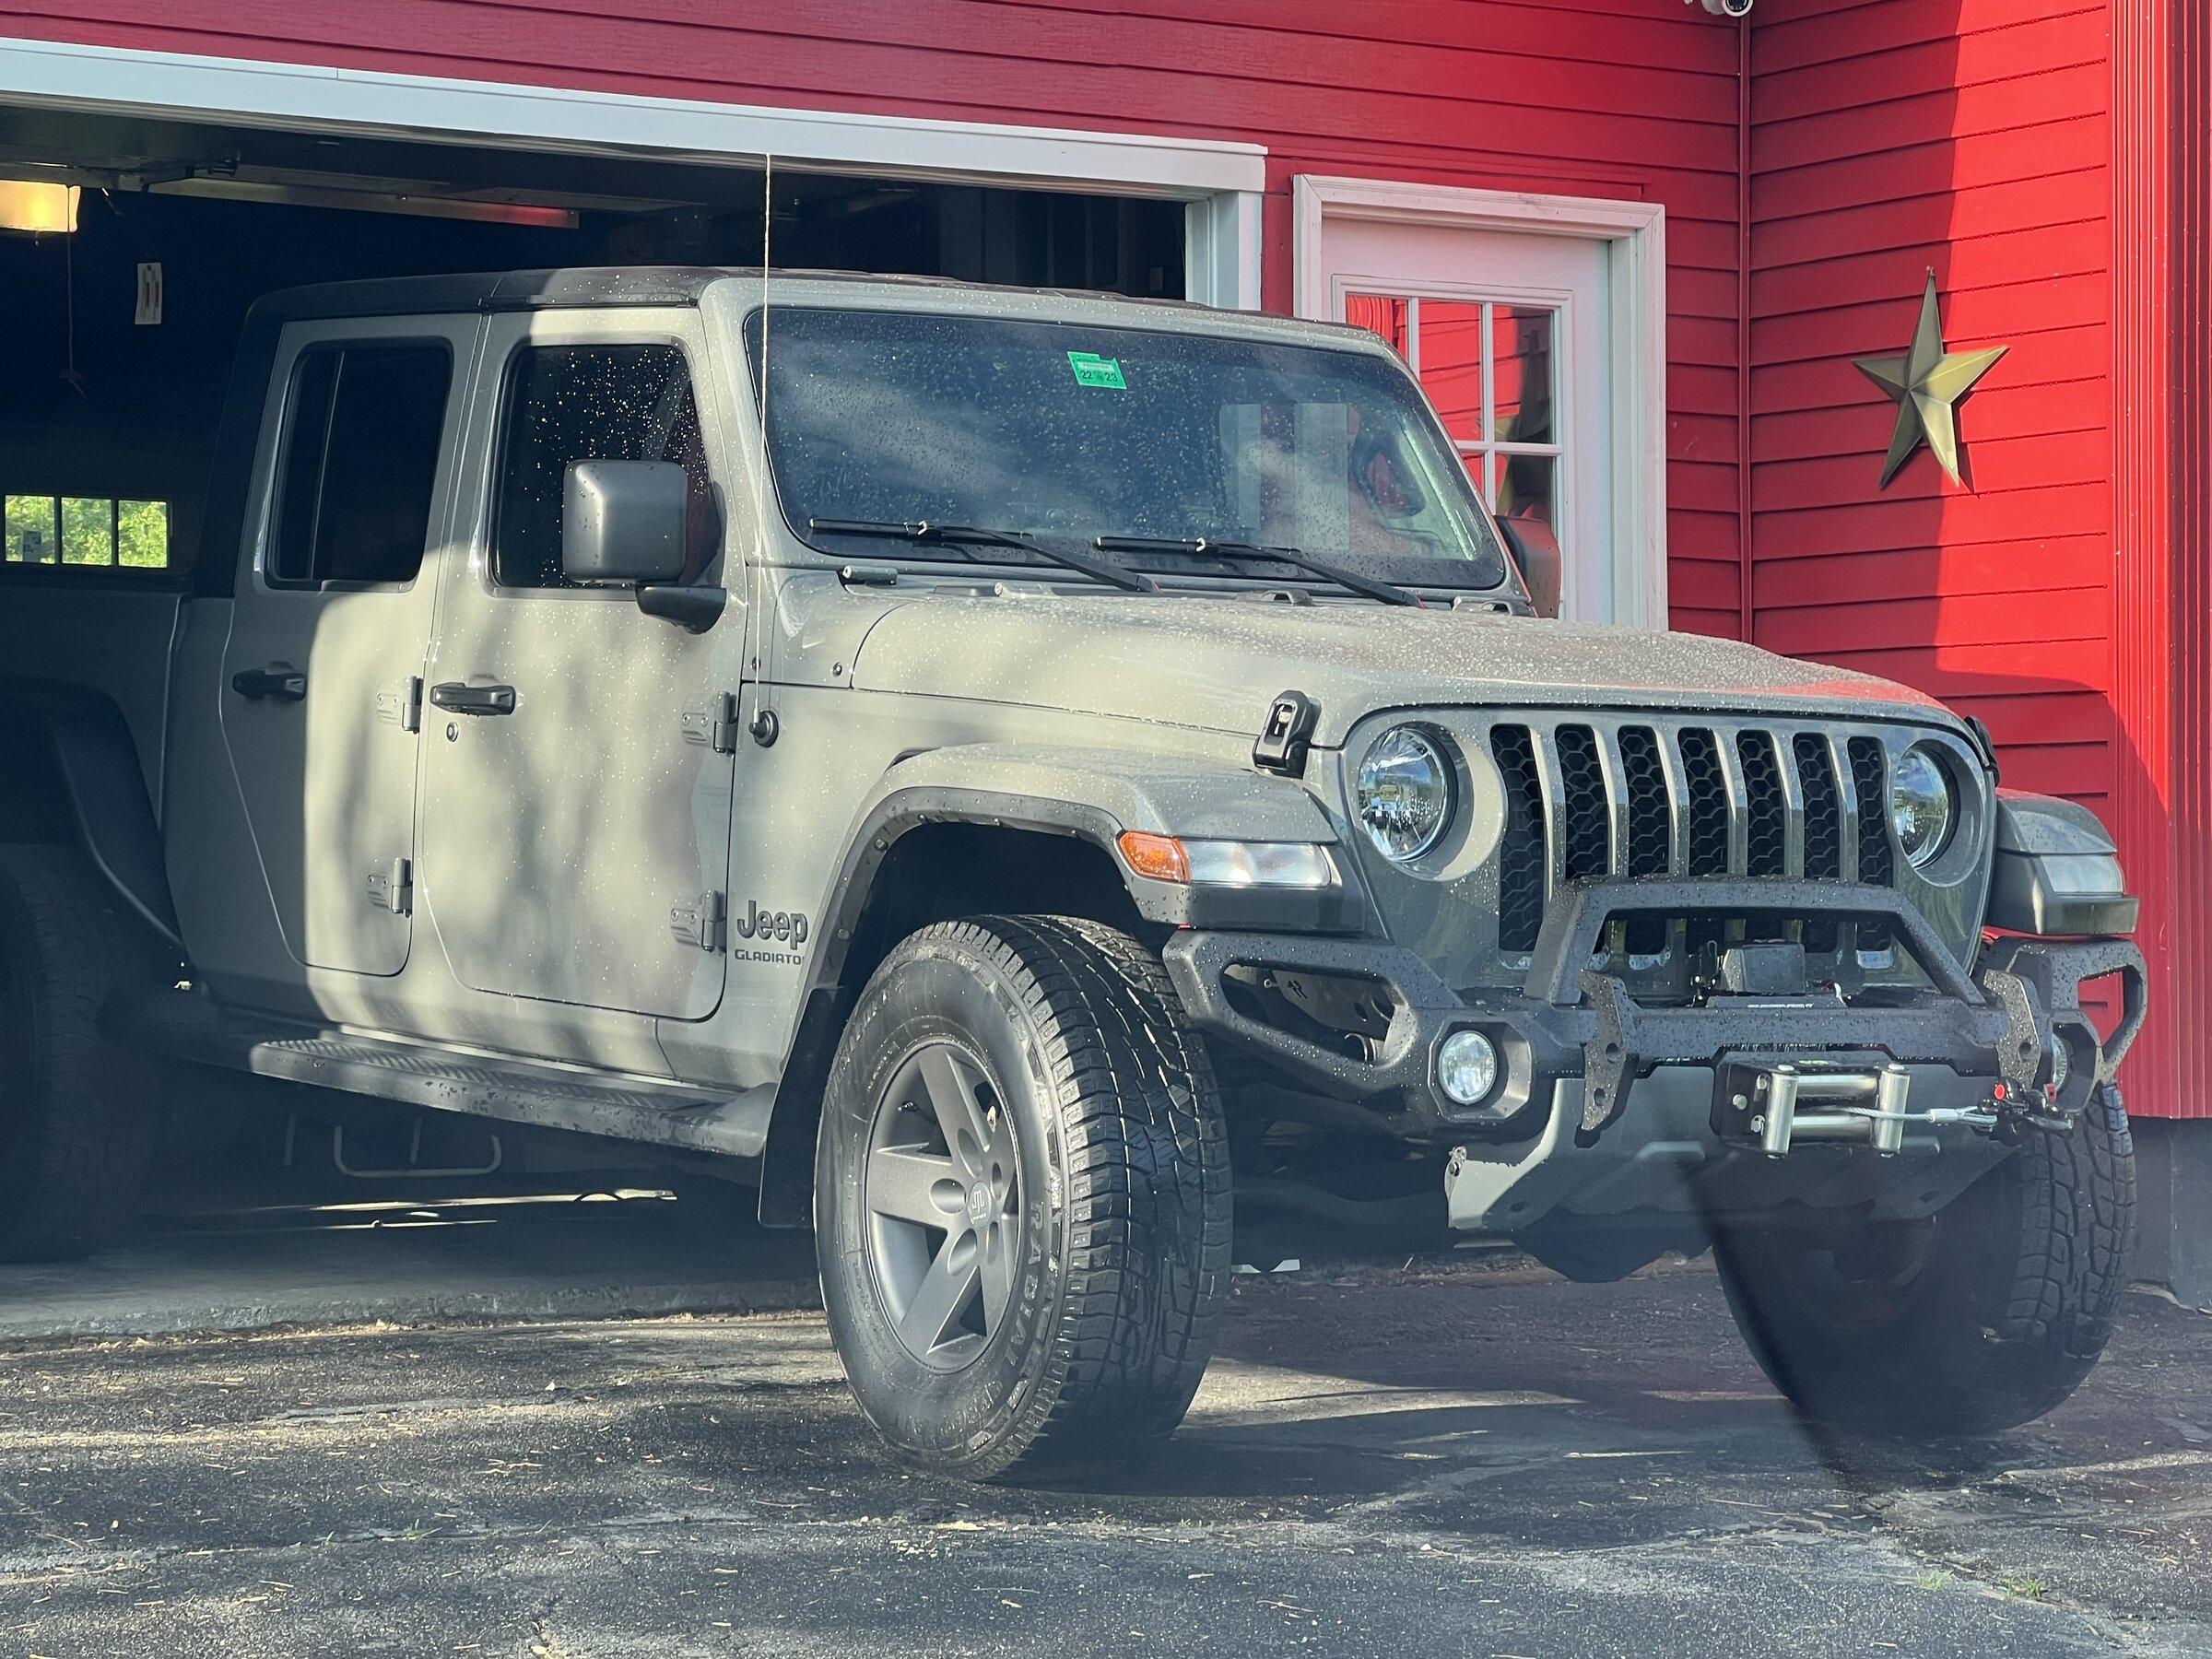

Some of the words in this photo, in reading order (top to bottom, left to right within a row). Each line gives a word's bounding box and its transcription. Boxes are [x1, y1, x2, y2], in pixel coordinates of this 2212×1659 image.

[1080, 370, 1094, 380] 22
[1104, 372, 1118, 382] 23
[736, 900, 808, 950] Jeep
[735, 948, 805, 965] GLADIATO
[1003, 1201, 1044, 1366] RADIAL
